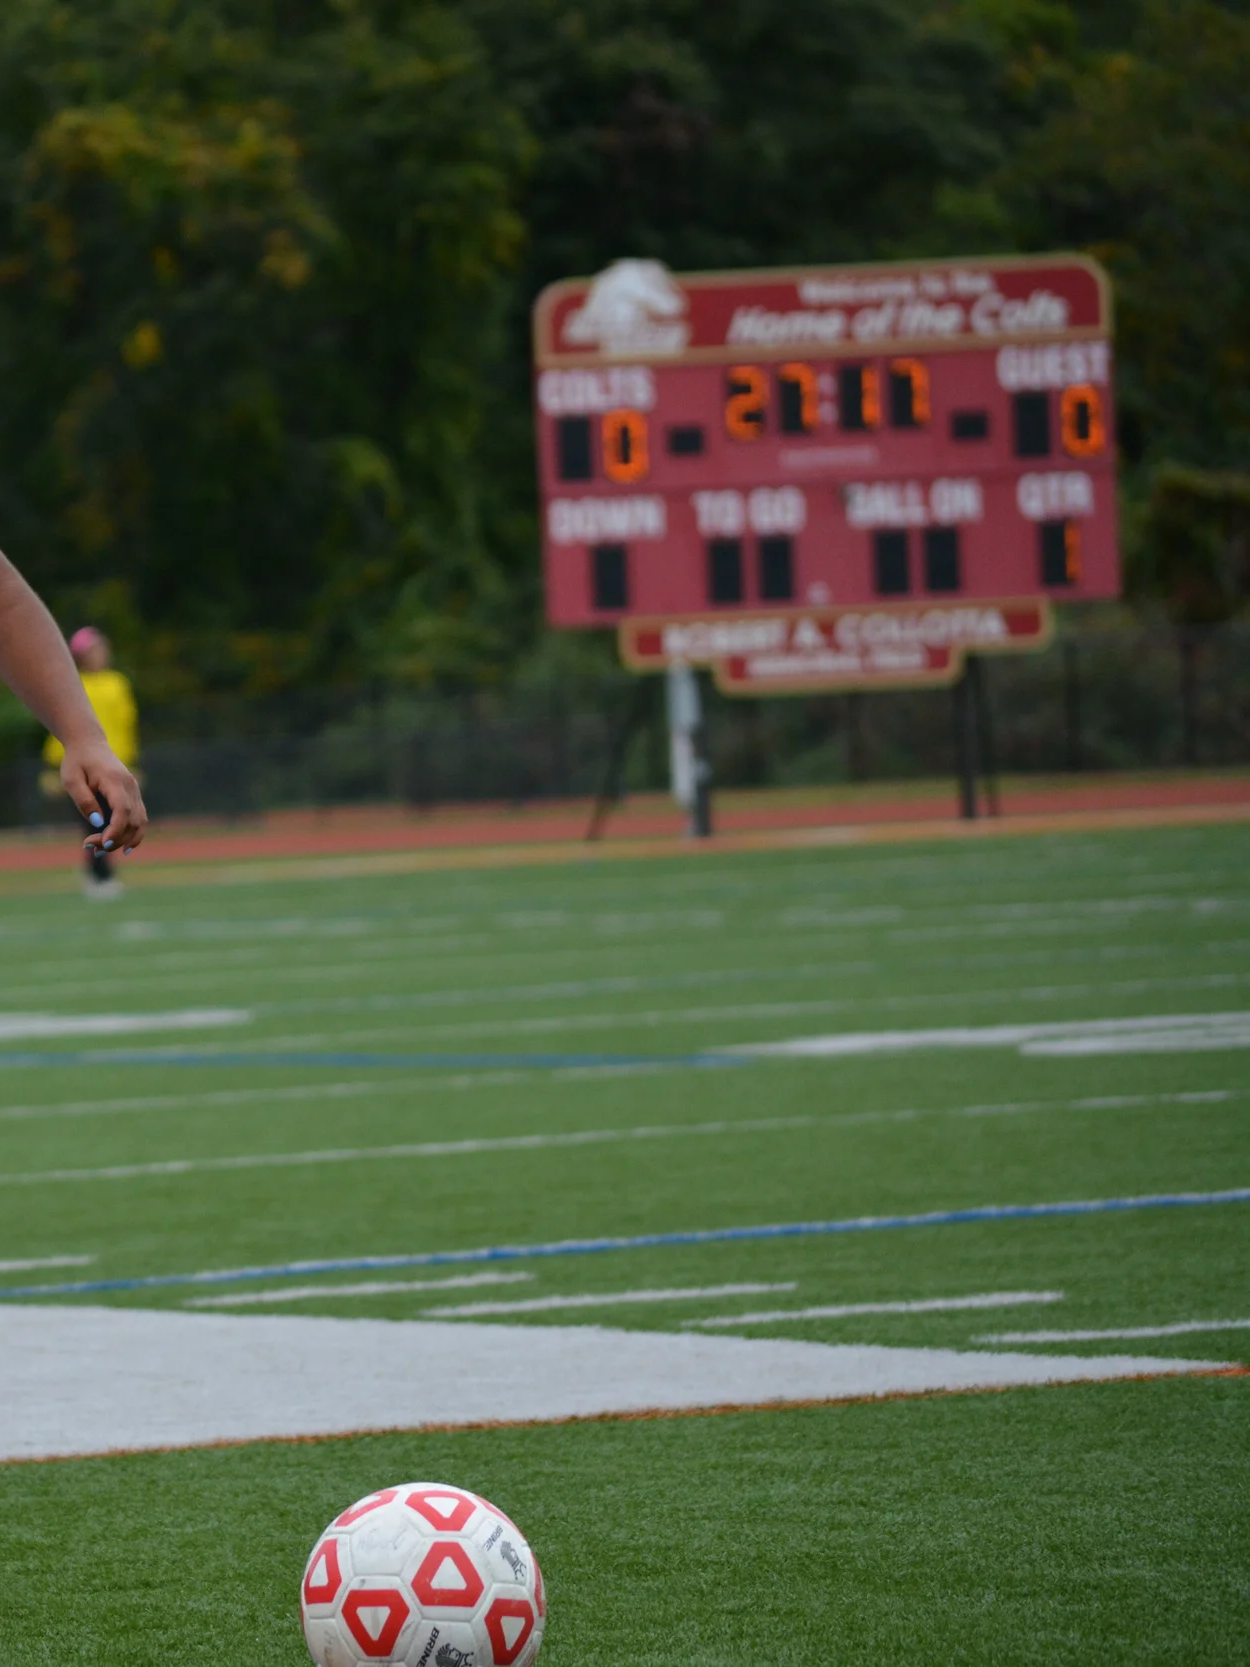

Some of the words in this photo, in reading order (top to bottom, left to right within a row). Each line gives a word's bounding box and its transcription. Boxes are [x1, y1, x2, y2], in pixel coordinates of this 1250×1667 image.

[727, 306, 845, 346] Home
[852, 298, 896, 342] of
[901, 299, 964, 338] the
[971, 290, 1068, 335] Colts
[539, 366, 655, 417] COLTS
[996, 341, 1110, 391] GUEST
[726, 358, 929, 440] 27:17
[1061, 384, 1105, 458] 0
[602, 409, 648, 481] 0
[548, 495, 666, 546] DOWN
[690, 489, 745, 537] TO
[748, 486, 807, 535] GO
[844, 481, 927, 528] BALL
[930, 477, 982, 525] ON
[1017, 471, 1093, 521] QTR
[482, 1525, 503, 1551] BRINE
